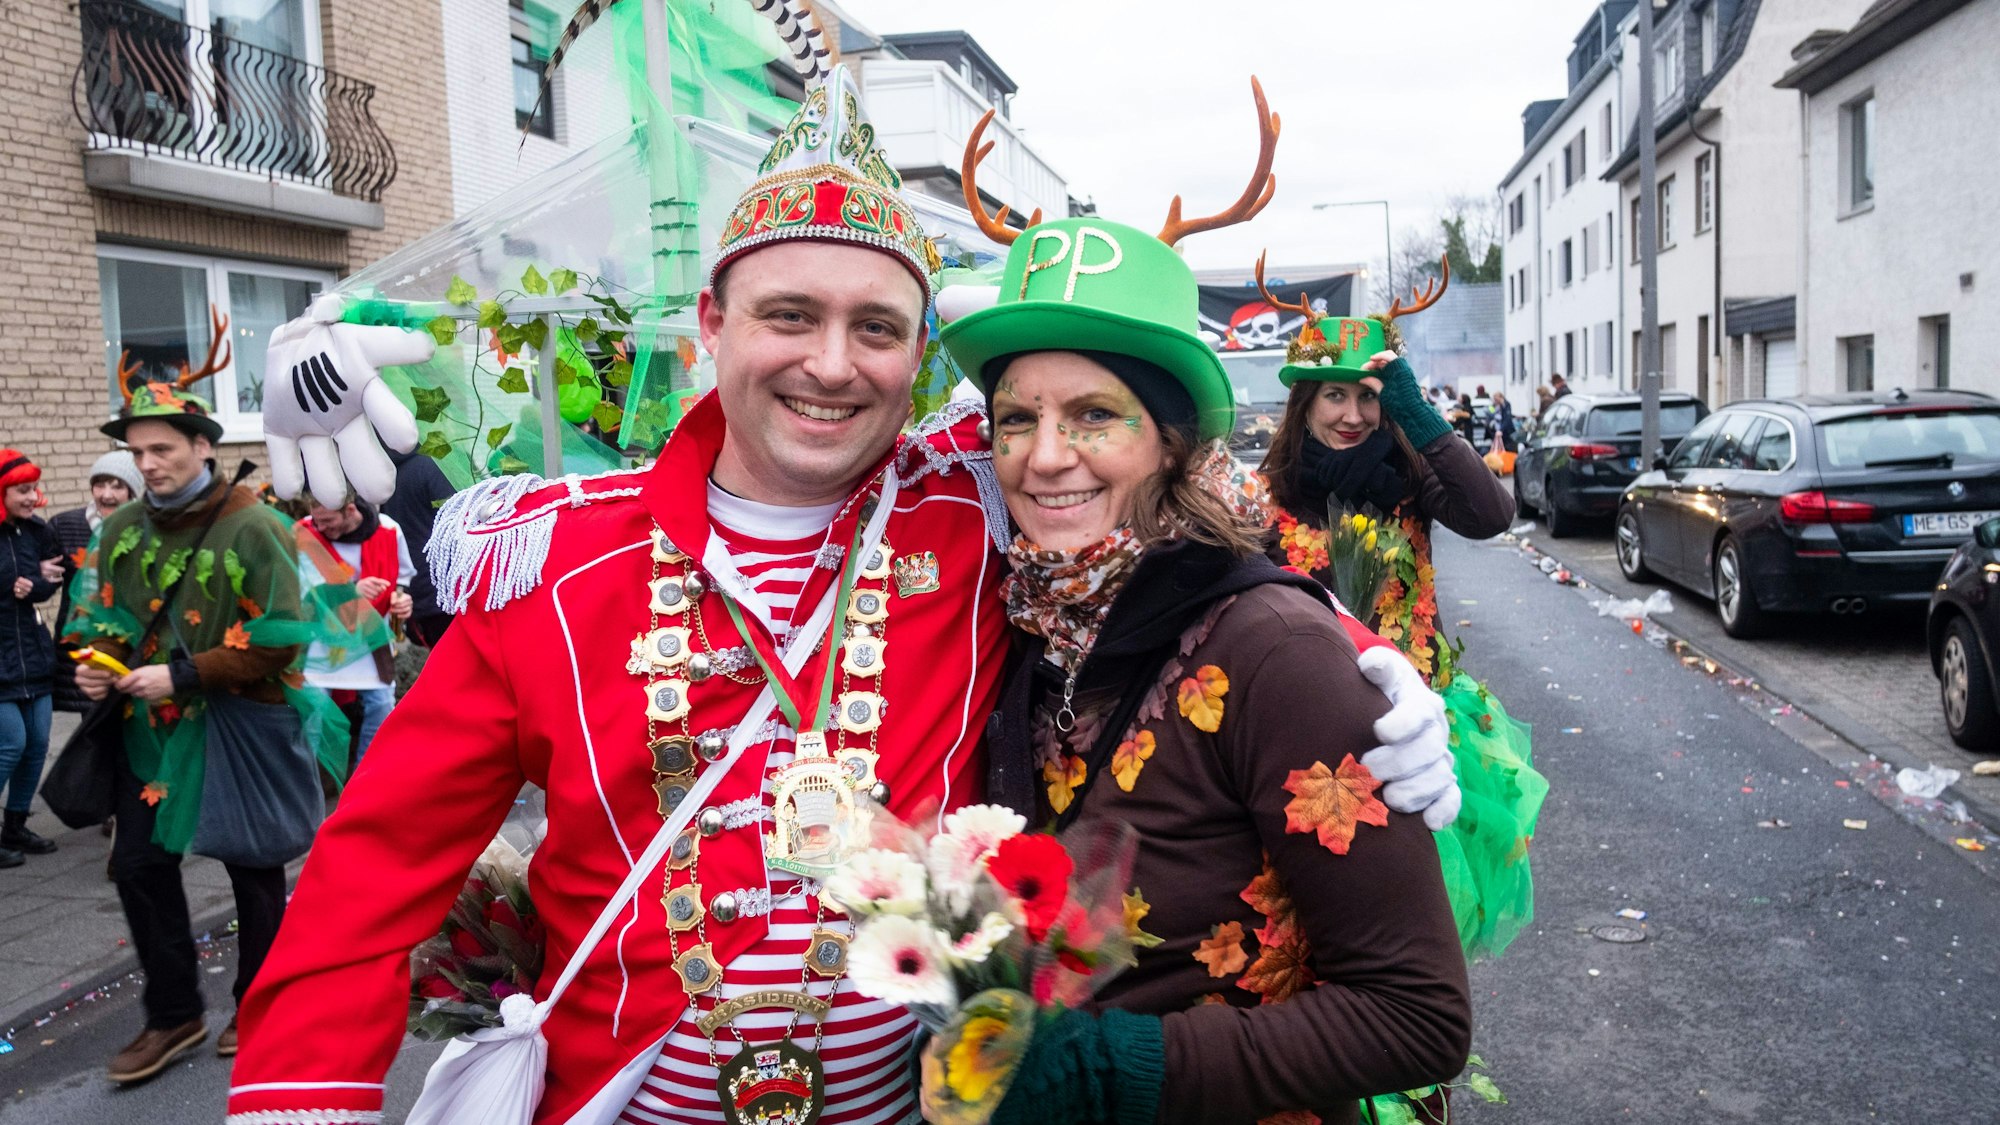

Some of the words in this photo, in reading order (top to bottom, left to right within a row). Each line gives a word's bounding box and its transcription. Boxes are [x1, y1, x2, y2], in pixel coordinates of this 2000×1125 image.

[1018, 226, 1123, 303] PP
[1339, 319, 1369, 351] PP
[1914, 515, 1937, 531] ME
[1947, 512, 1969, 529] GS
